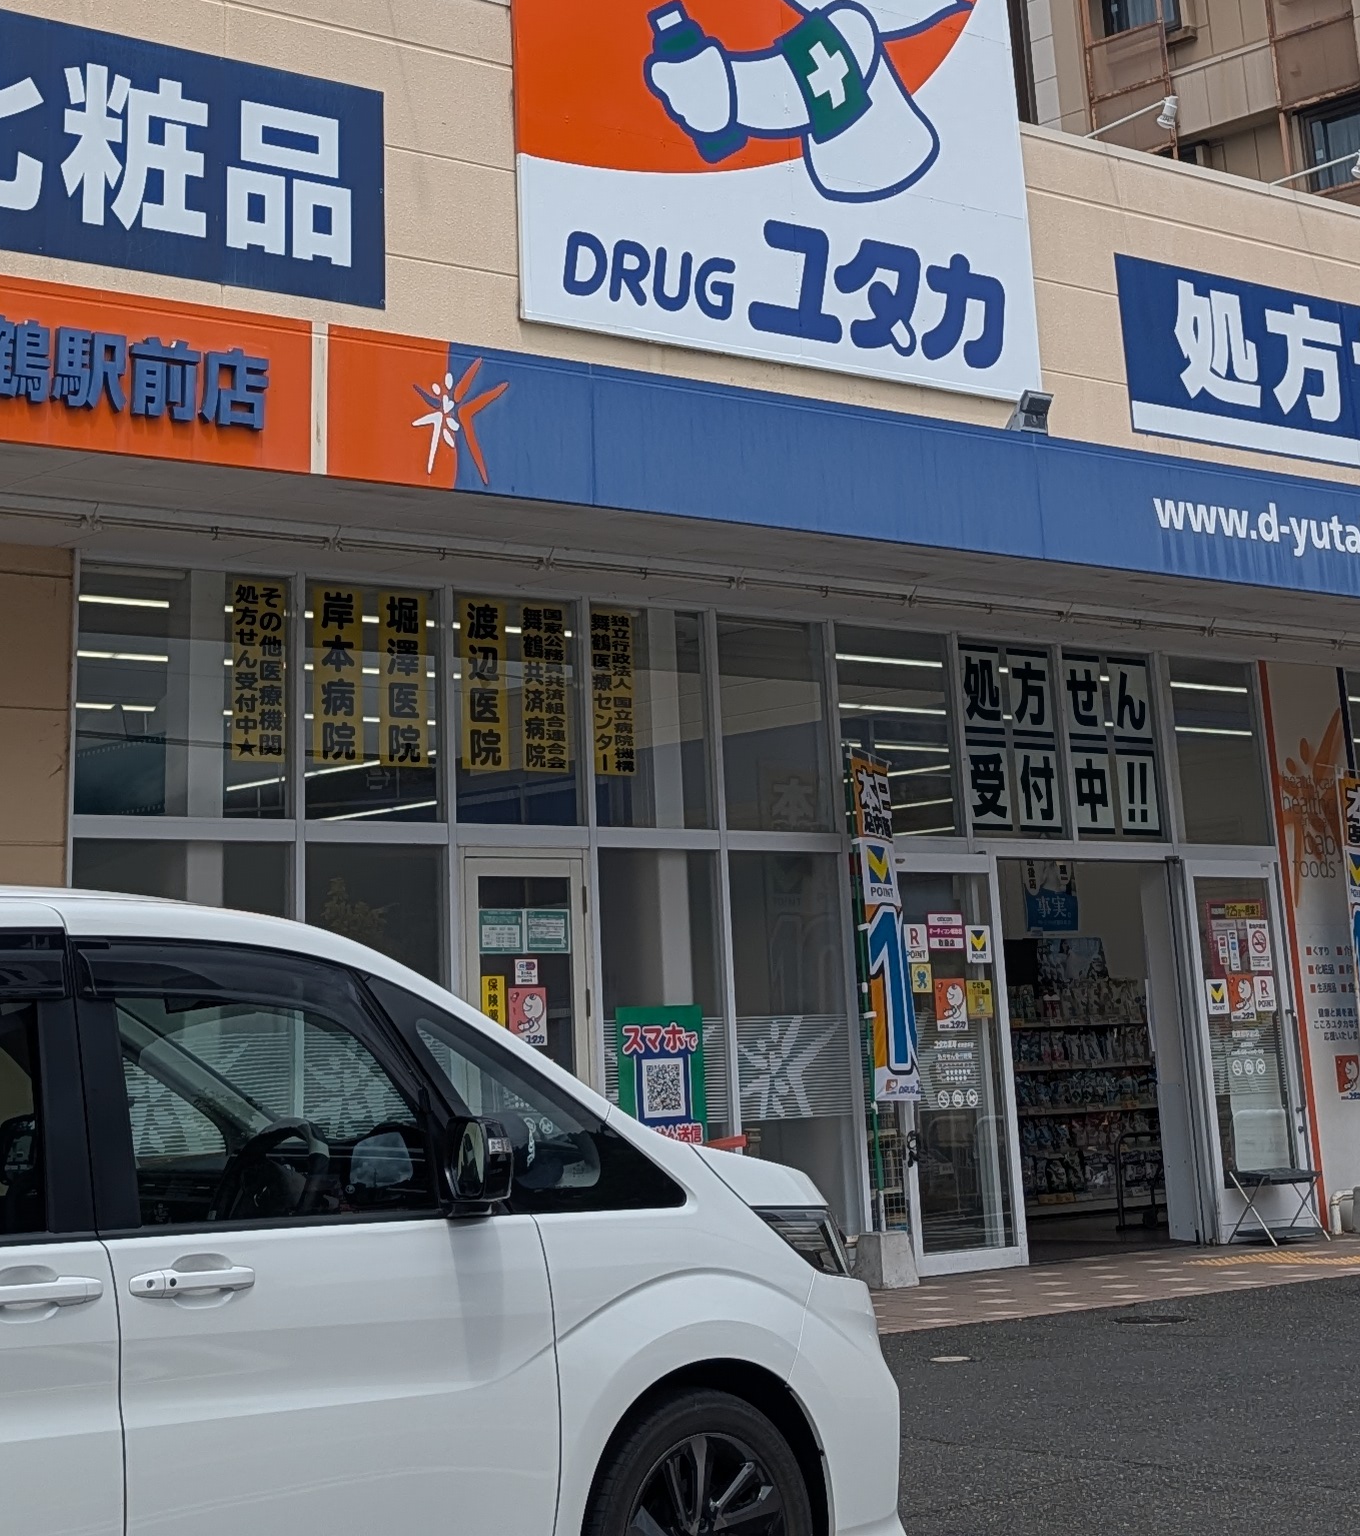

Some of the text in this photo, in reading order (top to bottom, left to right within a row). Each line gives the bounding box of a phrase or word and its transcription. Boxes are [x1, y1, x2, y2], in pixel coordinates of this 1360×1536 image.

[563, 219, 1005, 369] DRUG ユタカ
[258, 586, 282, 756] その他医療機関
[321, 592, 356, 761] 岸本病院
[386, 596, 421, 763] 堀澤医院
[467, 602, 502, 767] 渡辺医院
[522, 606, 546, 768] 舞鶴共済病院
[543, 608, 567, 769] 国家公務員共済組合連合会
[591, 613, 613, 771] 舞鶴医療センター
[963, 655, 1146, 732] 処方せん
[856, 766, 892, 817] 本日
[1304, 825, 1337, 856] bab
[870, 886, 894, 898] POINT
[909, 927, 920, 945] R
[1313, 946, 1329, 956] くすり
[1260, 979, 1269, 996] R
[1315, 964, 1334, 974] 化粧品
[1258, 999, 1274, 1008] POINT
[623, 1022, 698, 1054] スマホで
[652, 1123, 703, 1144] せん送信
